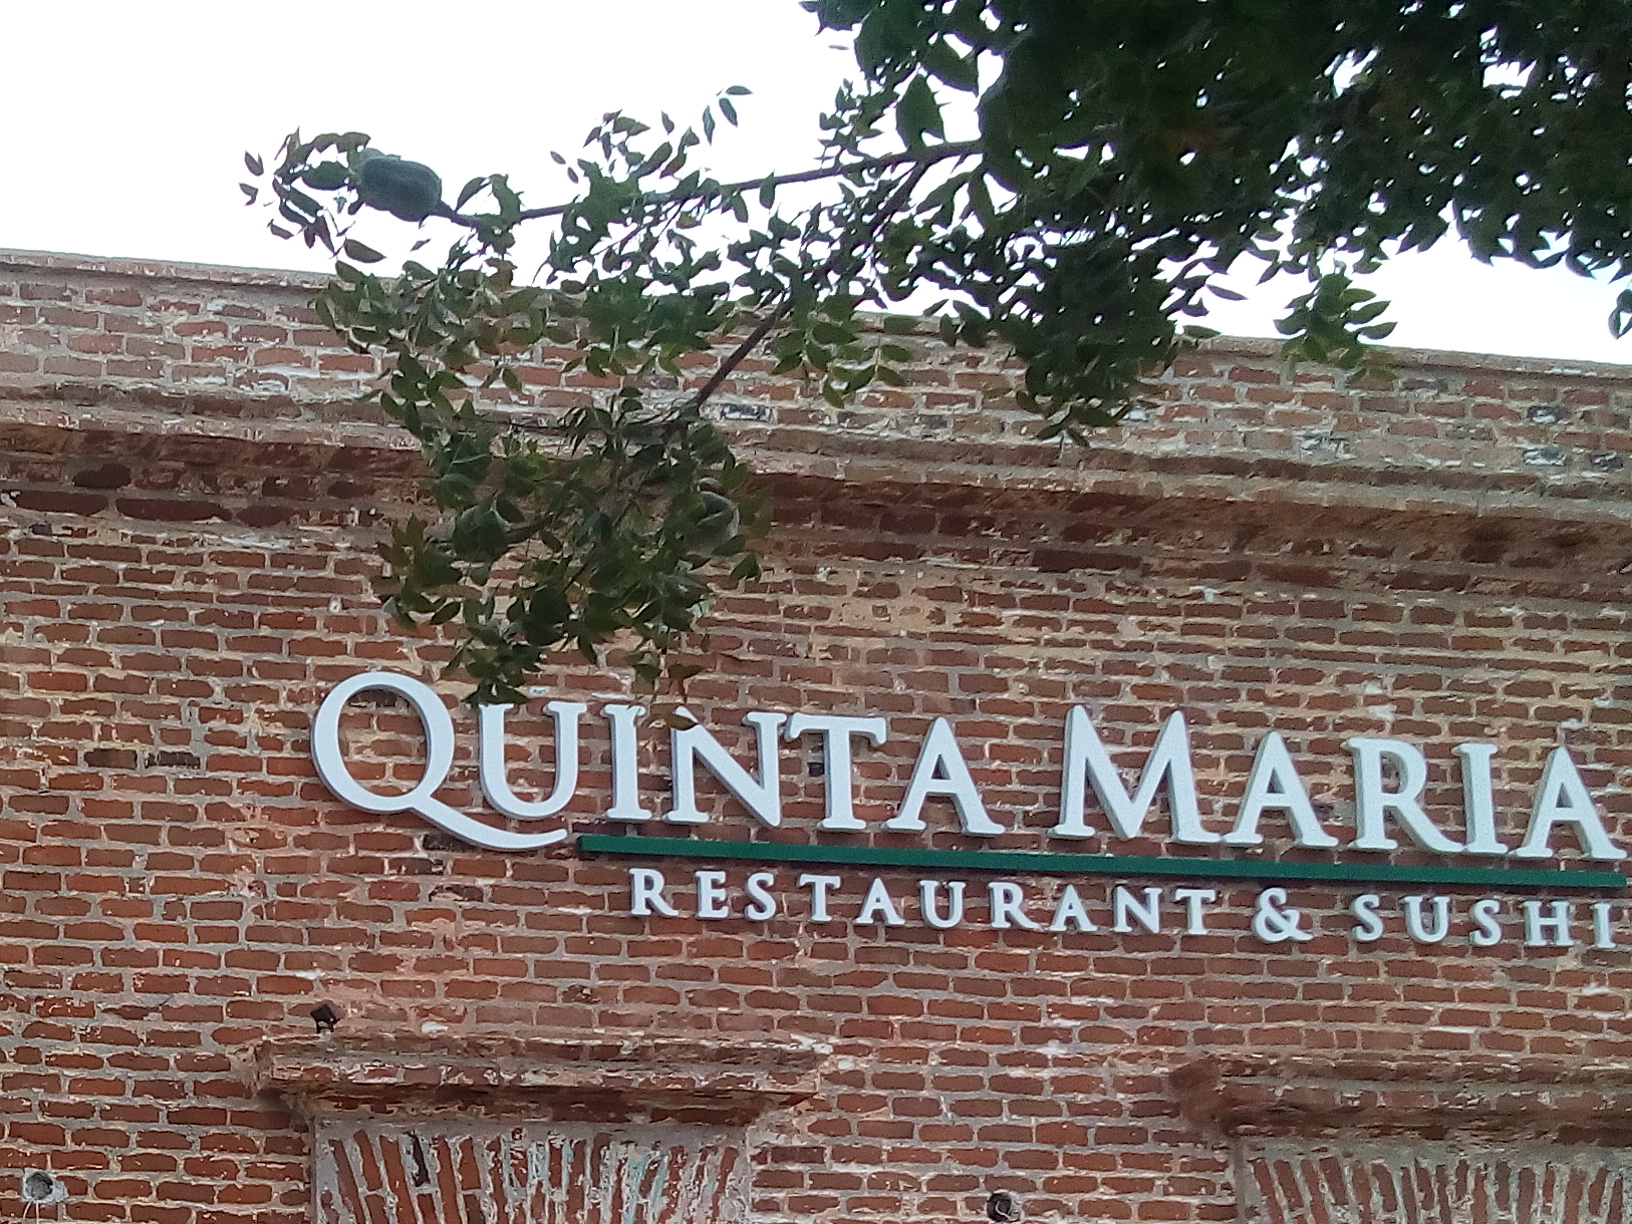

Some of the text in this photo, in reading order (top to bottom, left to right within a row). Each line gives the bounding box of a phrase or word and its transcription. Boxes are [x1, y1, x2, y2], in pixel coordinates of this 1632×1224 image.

[311, 670, 1628, 861] QUINTA MARIA
[628, 866, 1619, 950] RESTAURANT & SUSHI
